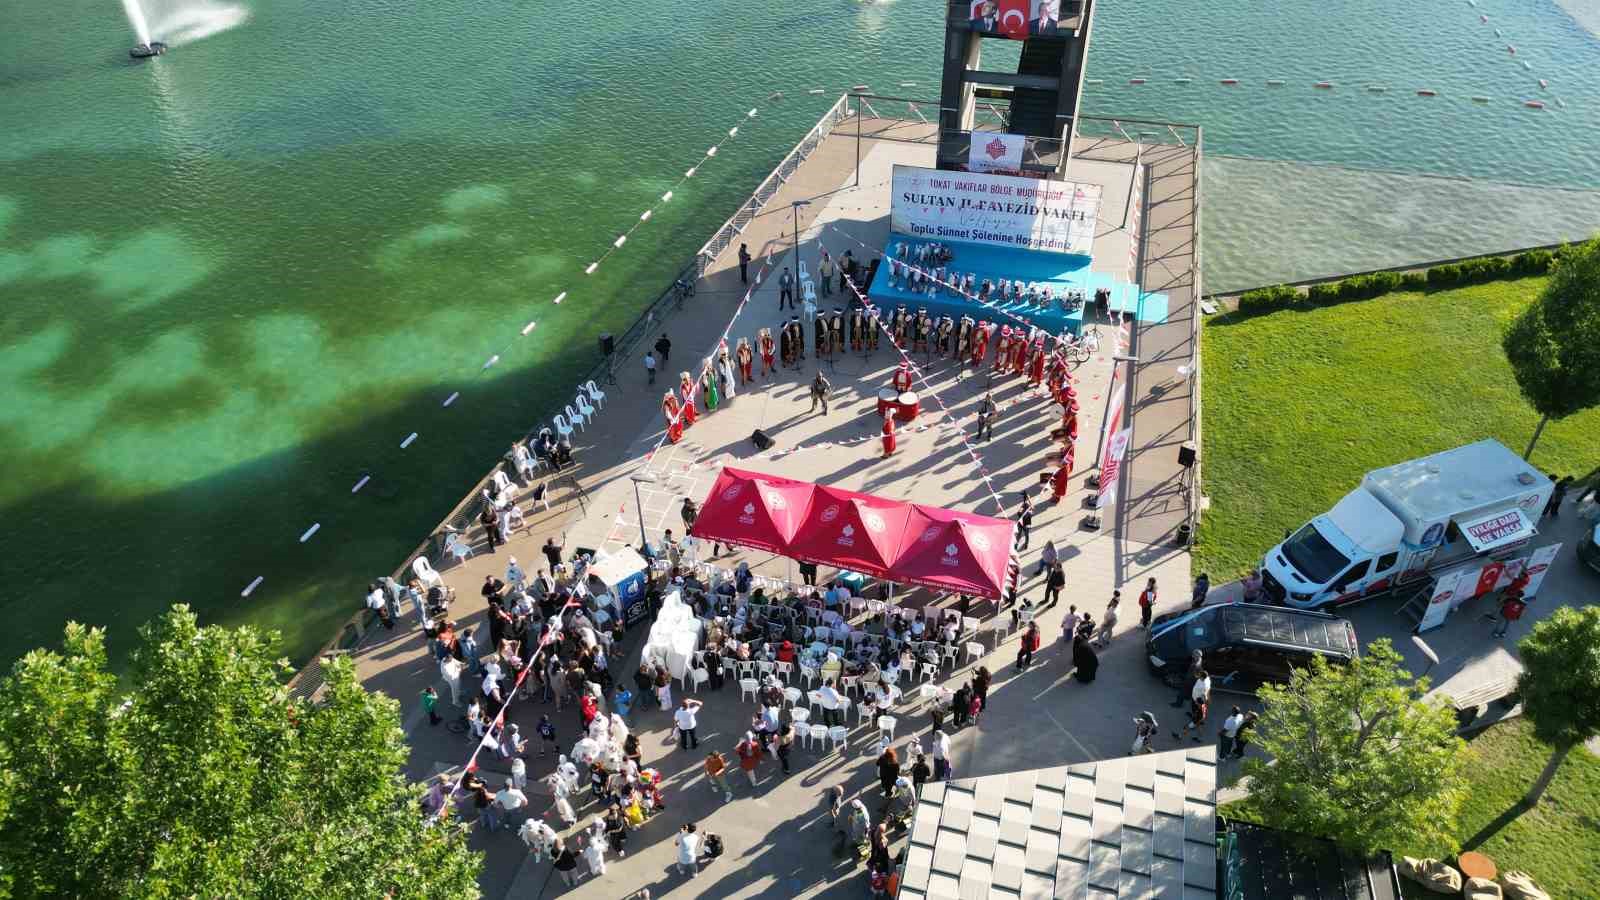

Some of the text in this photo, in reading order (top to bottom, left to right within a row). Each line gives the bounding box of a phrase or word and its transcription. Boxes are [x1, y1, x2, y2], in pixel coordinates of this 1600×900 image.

[903, 192, 955, 207] SULTAN
[911, 222, 935, 236] Toplu
[972, 229, 1013, 243] Şölenine
